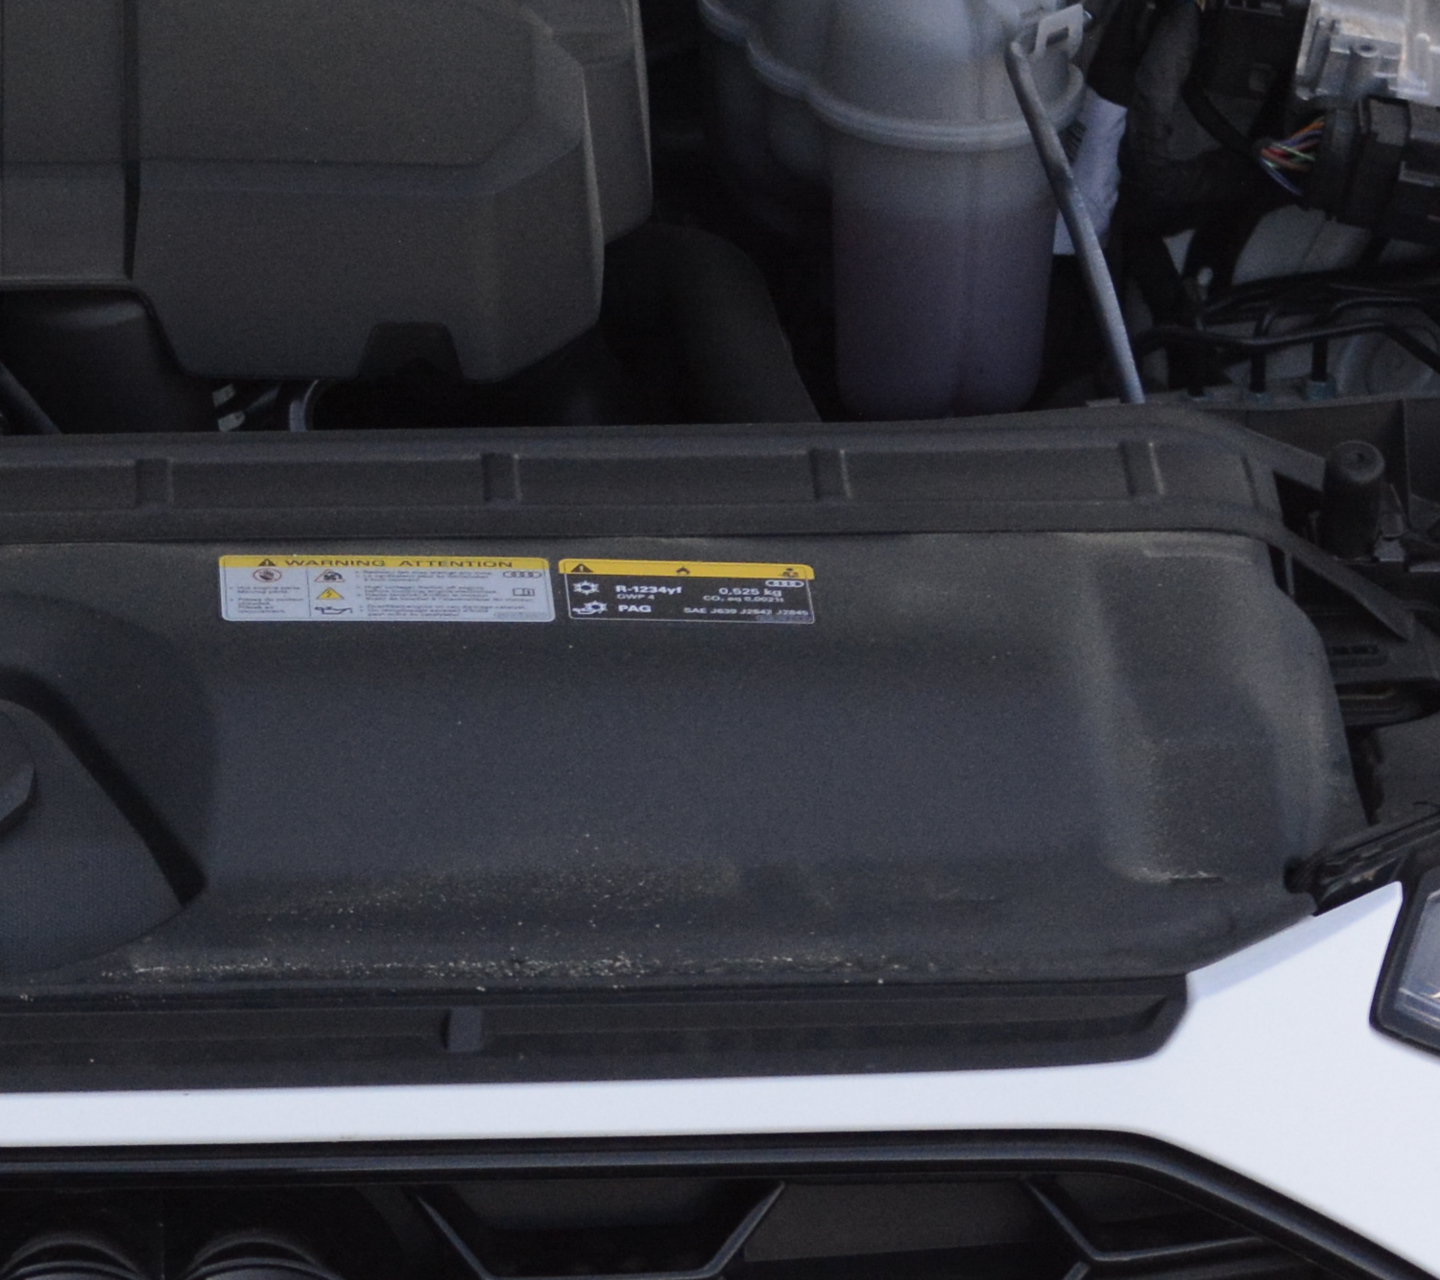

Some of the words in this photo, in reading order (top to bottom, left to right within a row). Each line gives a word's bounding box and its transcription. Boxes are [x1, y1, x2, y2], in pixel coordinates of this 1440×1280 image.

[399, 560, 513, 568] ATTENTION
[615, 585, 682, 595] R-1234yf
[763, 589, 782, 597] kg
